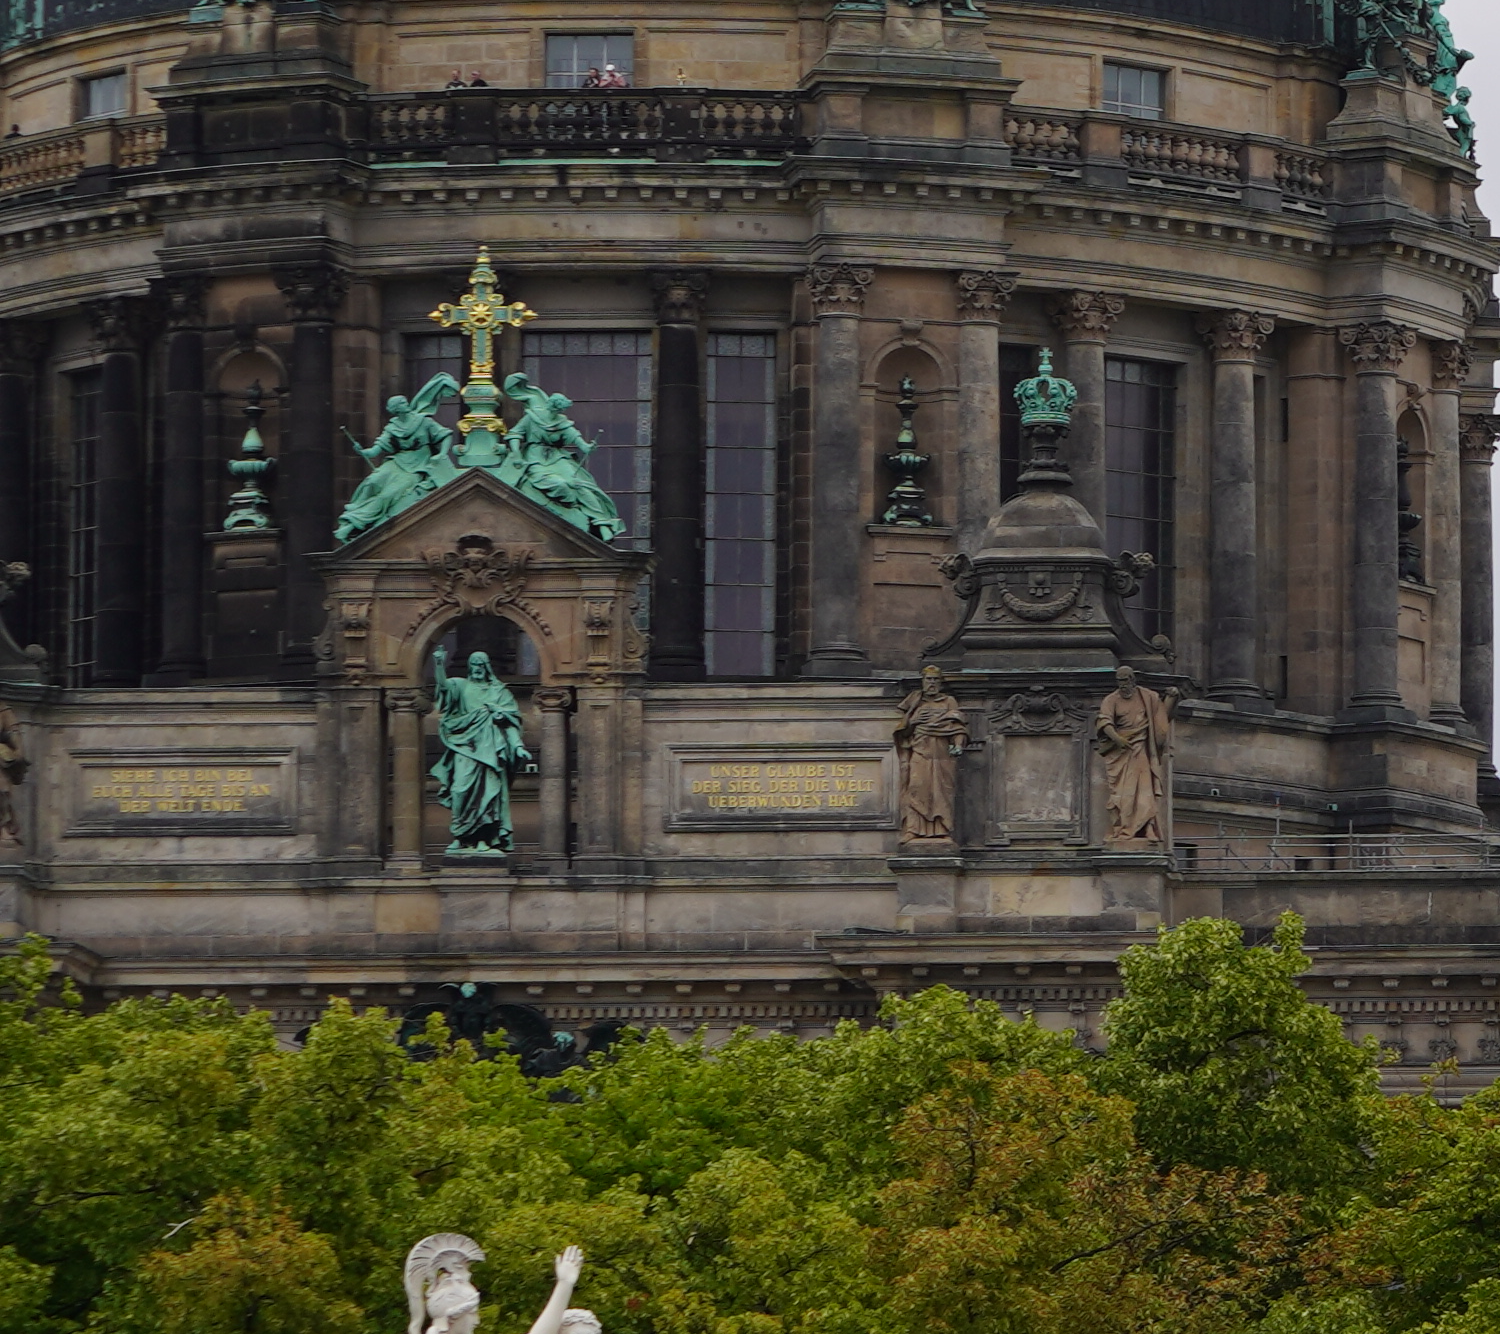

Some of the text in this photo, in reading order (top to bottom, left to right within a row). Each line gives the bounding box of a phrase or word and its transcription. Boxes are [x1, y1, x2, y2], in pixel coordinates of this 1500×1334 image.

[163, 770, 190, 782] ICH
[194, 769, 222, 782] BIN
[227, 769, 253, 781] BEI
[709, 764, 855, 778] UNSER GLAUBE IST
[92, 783, 271, 798] EUCH ALLE TAGE BIS AN
[692, 780, 722, 794] DER
[769, 779, 799, 793] DER
[805, 779, 830, 792] DIE
[835, 779, 875, 792] WELT
[119, 800, 151, 813] DER
[155, 800, 196, 813] WELT
[708, 795, 823, 809] UEBERWUNDEN
